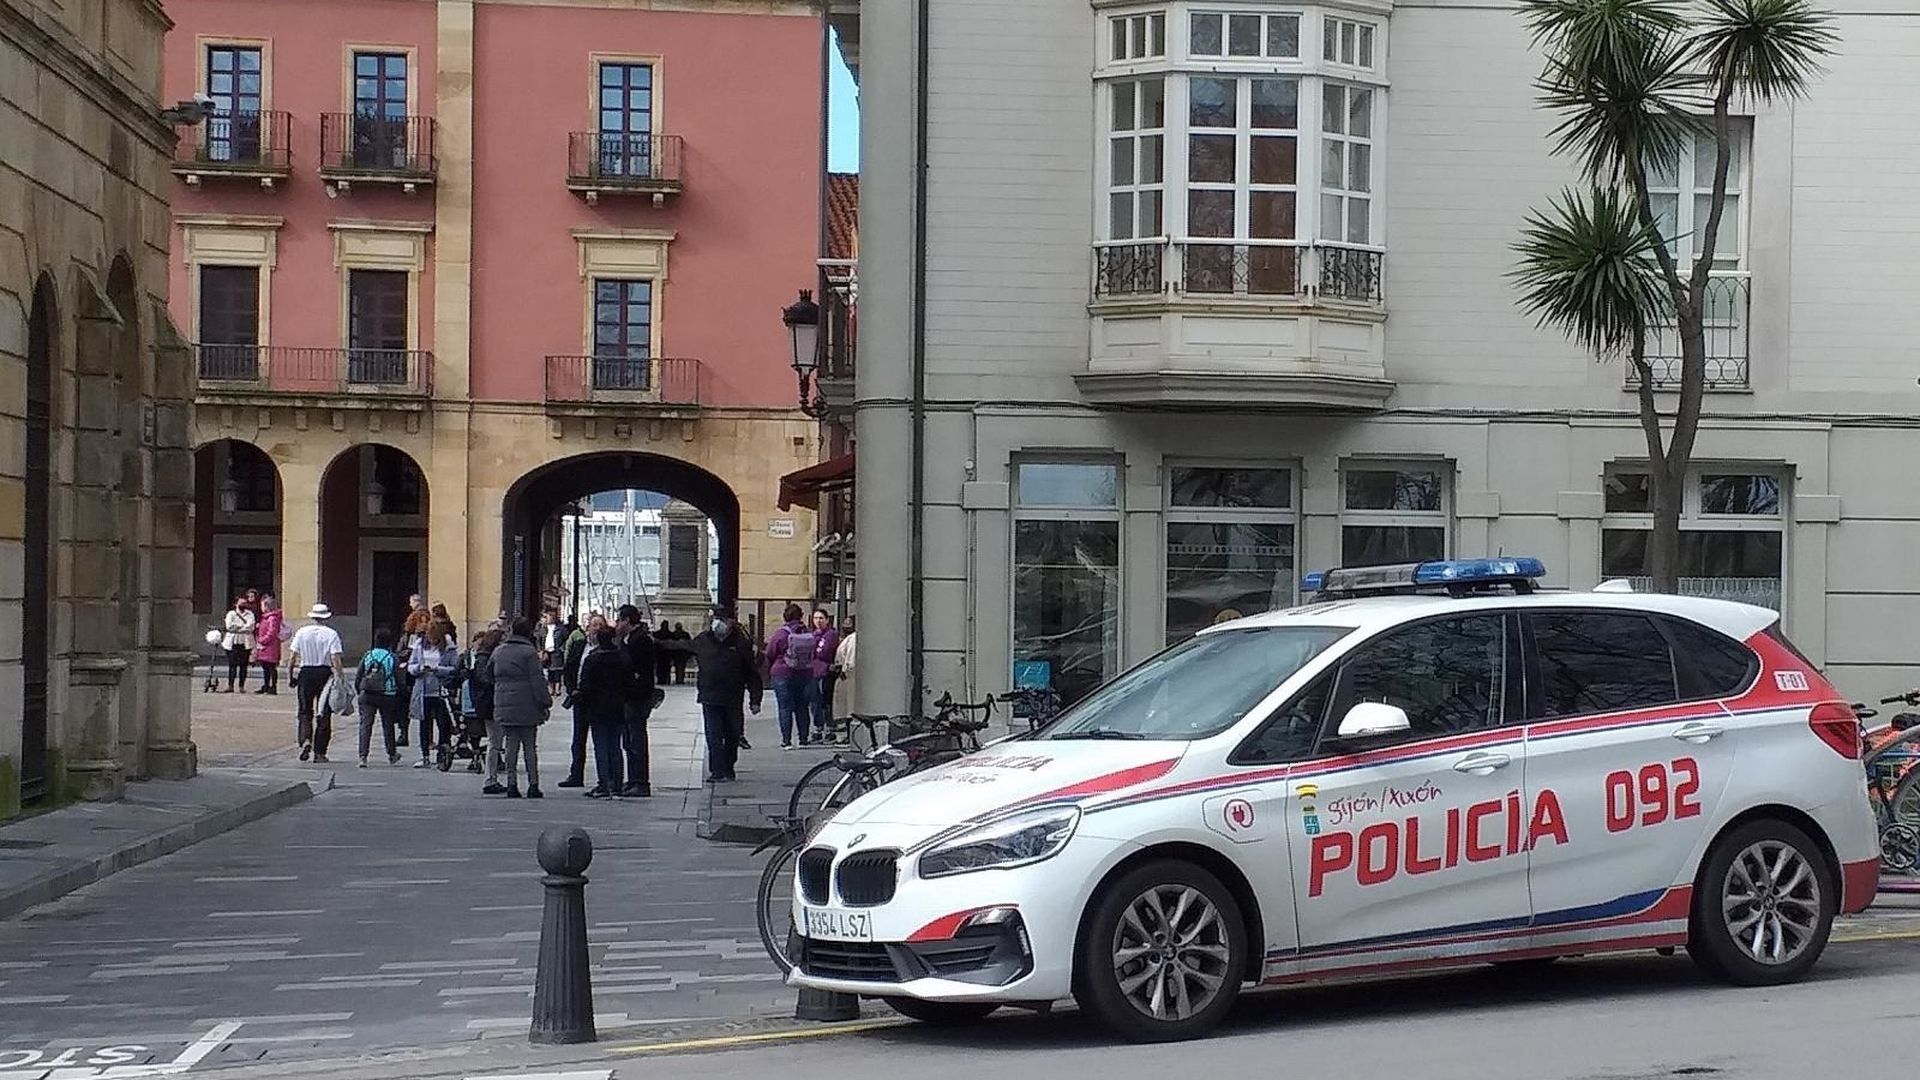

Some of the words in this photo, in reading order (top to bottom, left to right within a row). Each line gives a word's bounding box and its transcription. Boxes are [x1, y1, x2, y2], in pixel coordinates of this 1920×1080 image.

[1606, 757, 1701, 832] 092
[1308, 789, 1569, 897] POLICÍA
[810, 912, 837, 936] 3354
[840, 913, 867, 937] LSZ
